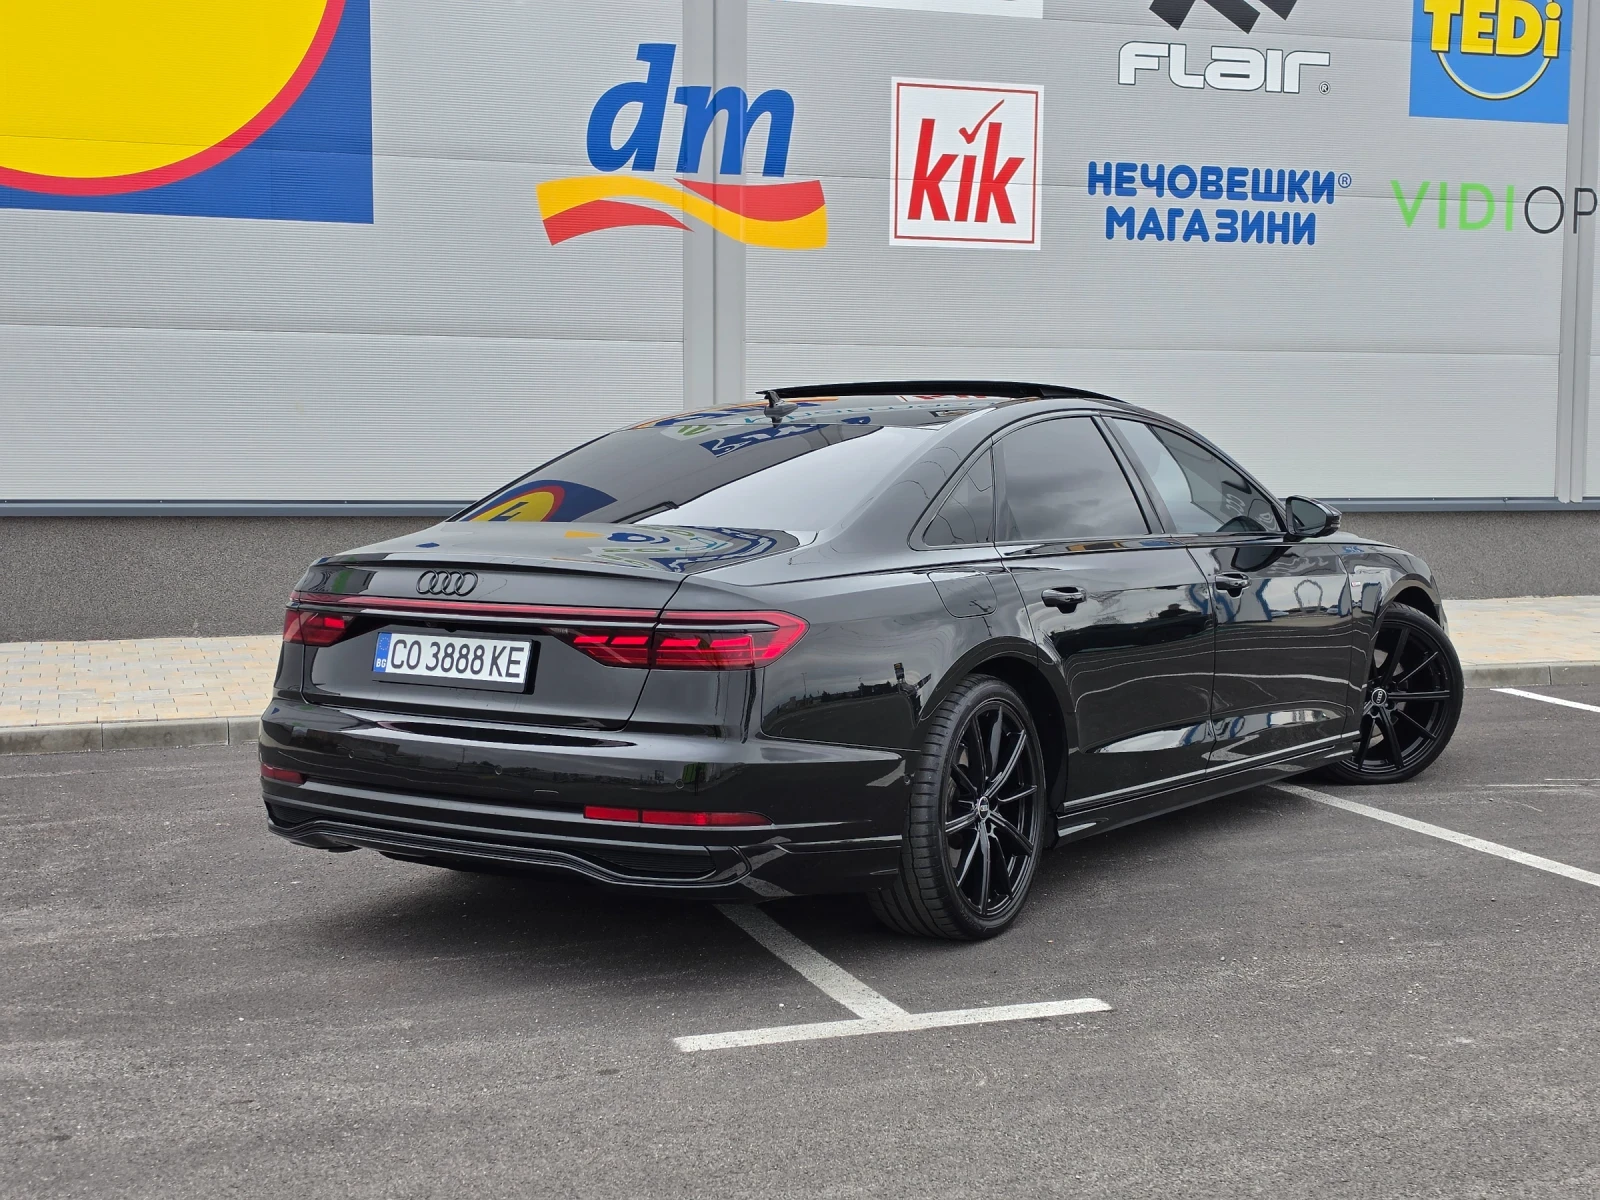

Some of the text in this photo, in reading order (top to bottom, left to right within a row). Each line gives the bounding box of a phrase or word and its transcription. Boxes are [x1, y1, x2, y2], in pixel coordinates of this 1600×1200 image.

[1424, 0, 1562, 58] TEDi
[586, 43, 795, 178] dm
[907, 99, 1026, 224] kik
[1105, 205, 1316, 246] МАГАЗИНИ
[1390, 180, 1598, 234] VIDIOP
[375, 658, 387, 669] BG
[425, 641, 485, 675] 3888
